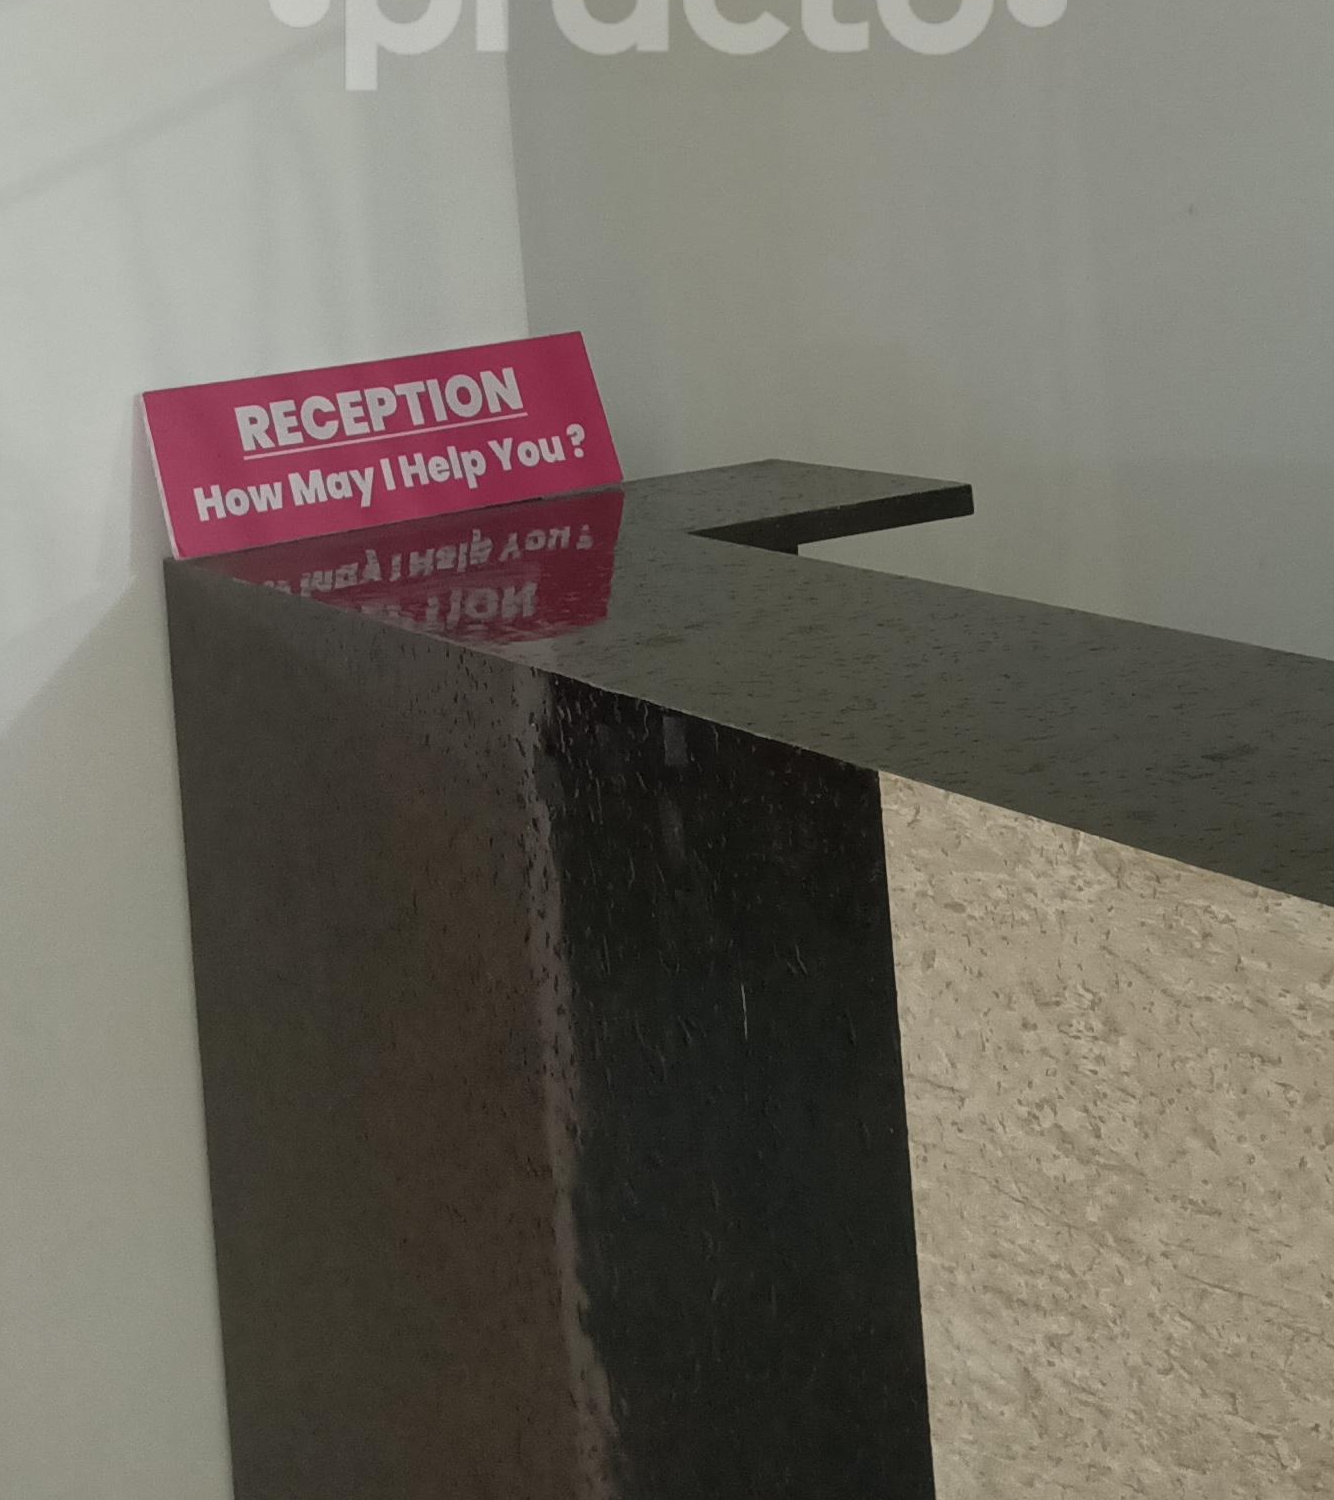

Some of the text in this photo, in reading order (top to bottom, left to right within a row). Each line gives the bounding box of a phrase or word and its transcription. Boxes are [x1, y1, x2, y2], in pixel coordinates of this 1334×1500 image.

[234, 367, 524, 452] RECEPTION
[193, 481, 284, 521] How
[288, 463, 375, 508] May
[385, 458, 397, 491] I
[399, 448, 487, 489] Help
